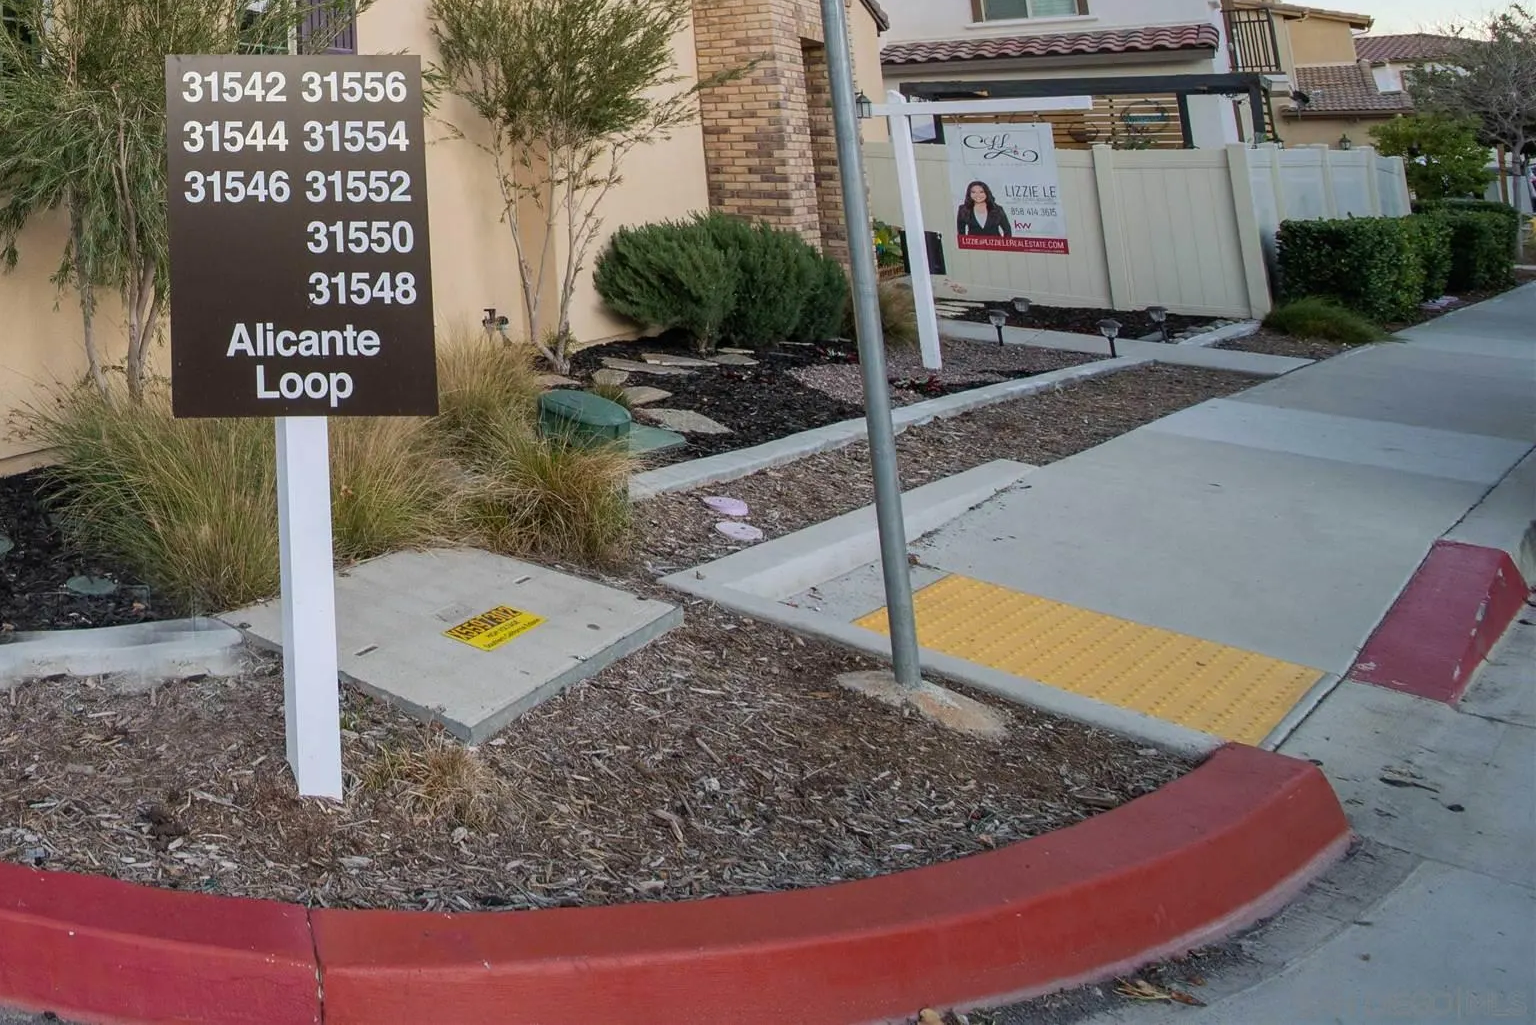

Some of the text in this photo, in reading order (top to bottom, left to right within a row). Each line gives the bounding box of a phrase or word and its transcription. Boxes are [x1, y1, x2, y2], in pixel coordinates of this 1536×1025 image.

[182, 71, 407, 103] 31542 31556
[183, 121, 409, 152] 31544 31554
[184, 170, 412, 203] 31546 31552
[1005, 184, 1057, 198] LIZZIE LE
[306, 221, 414, 253] 31550
[1014, 219, 1032, 230] kw
[308, 272, 417, 305] 31548
[226, 322, 381, 357] Alicante
[256, 365, 353, 408] Loop
